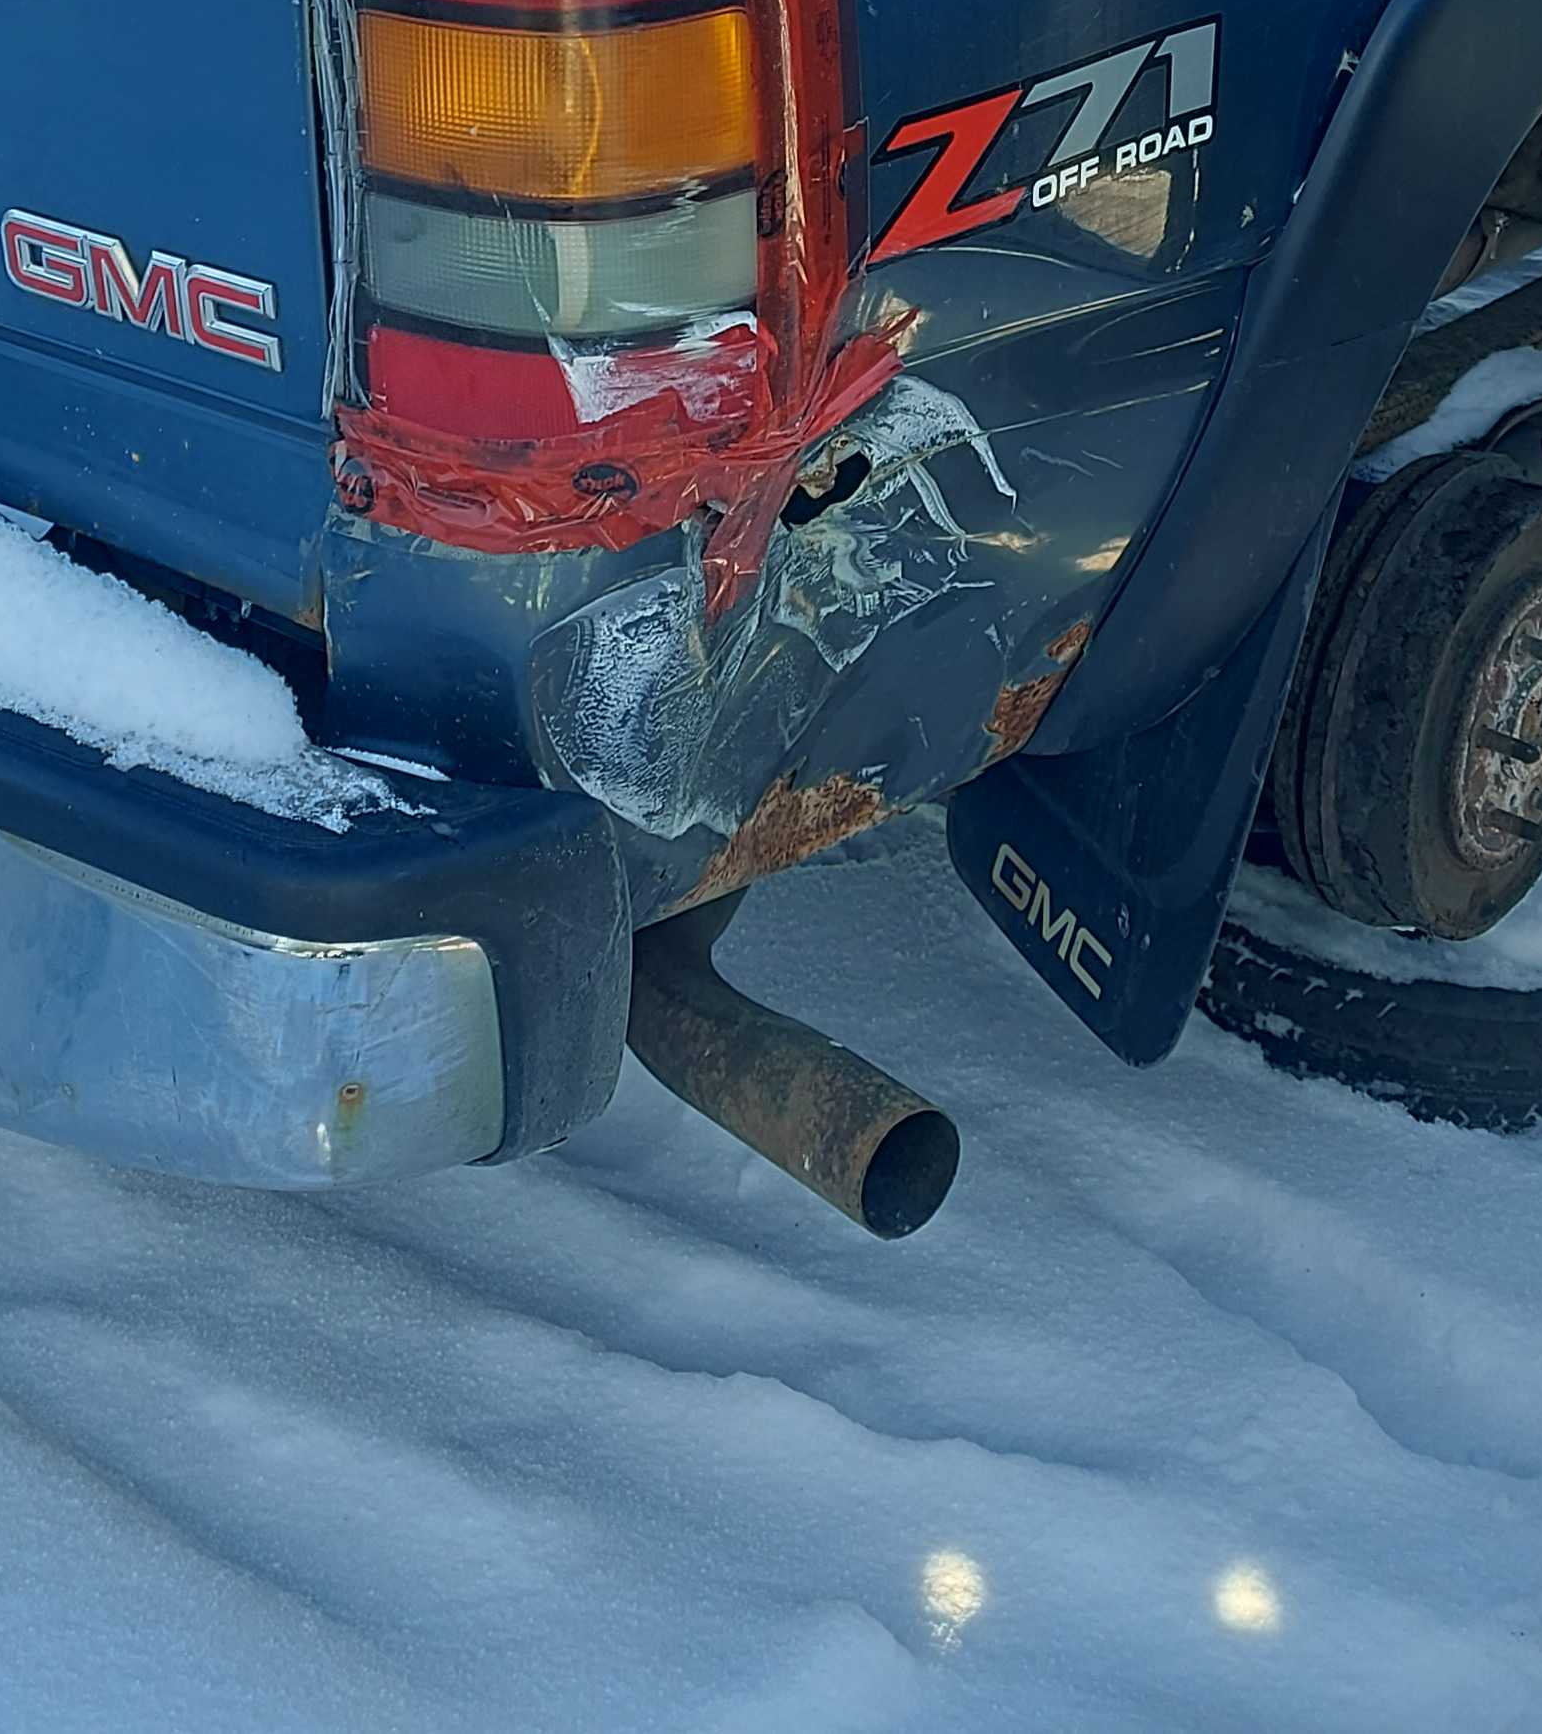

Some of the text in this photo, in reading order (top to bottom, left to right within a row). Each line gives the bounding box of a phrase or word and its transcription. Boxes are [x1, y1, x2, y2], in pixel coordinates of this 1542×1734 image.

[867, 22, 1217, 266] Z71
[1031, 113, 1214, 209] OFF ROAD
[0, 207, 284, 373] GMC
[991, 842, 1113, 1001] GMC
